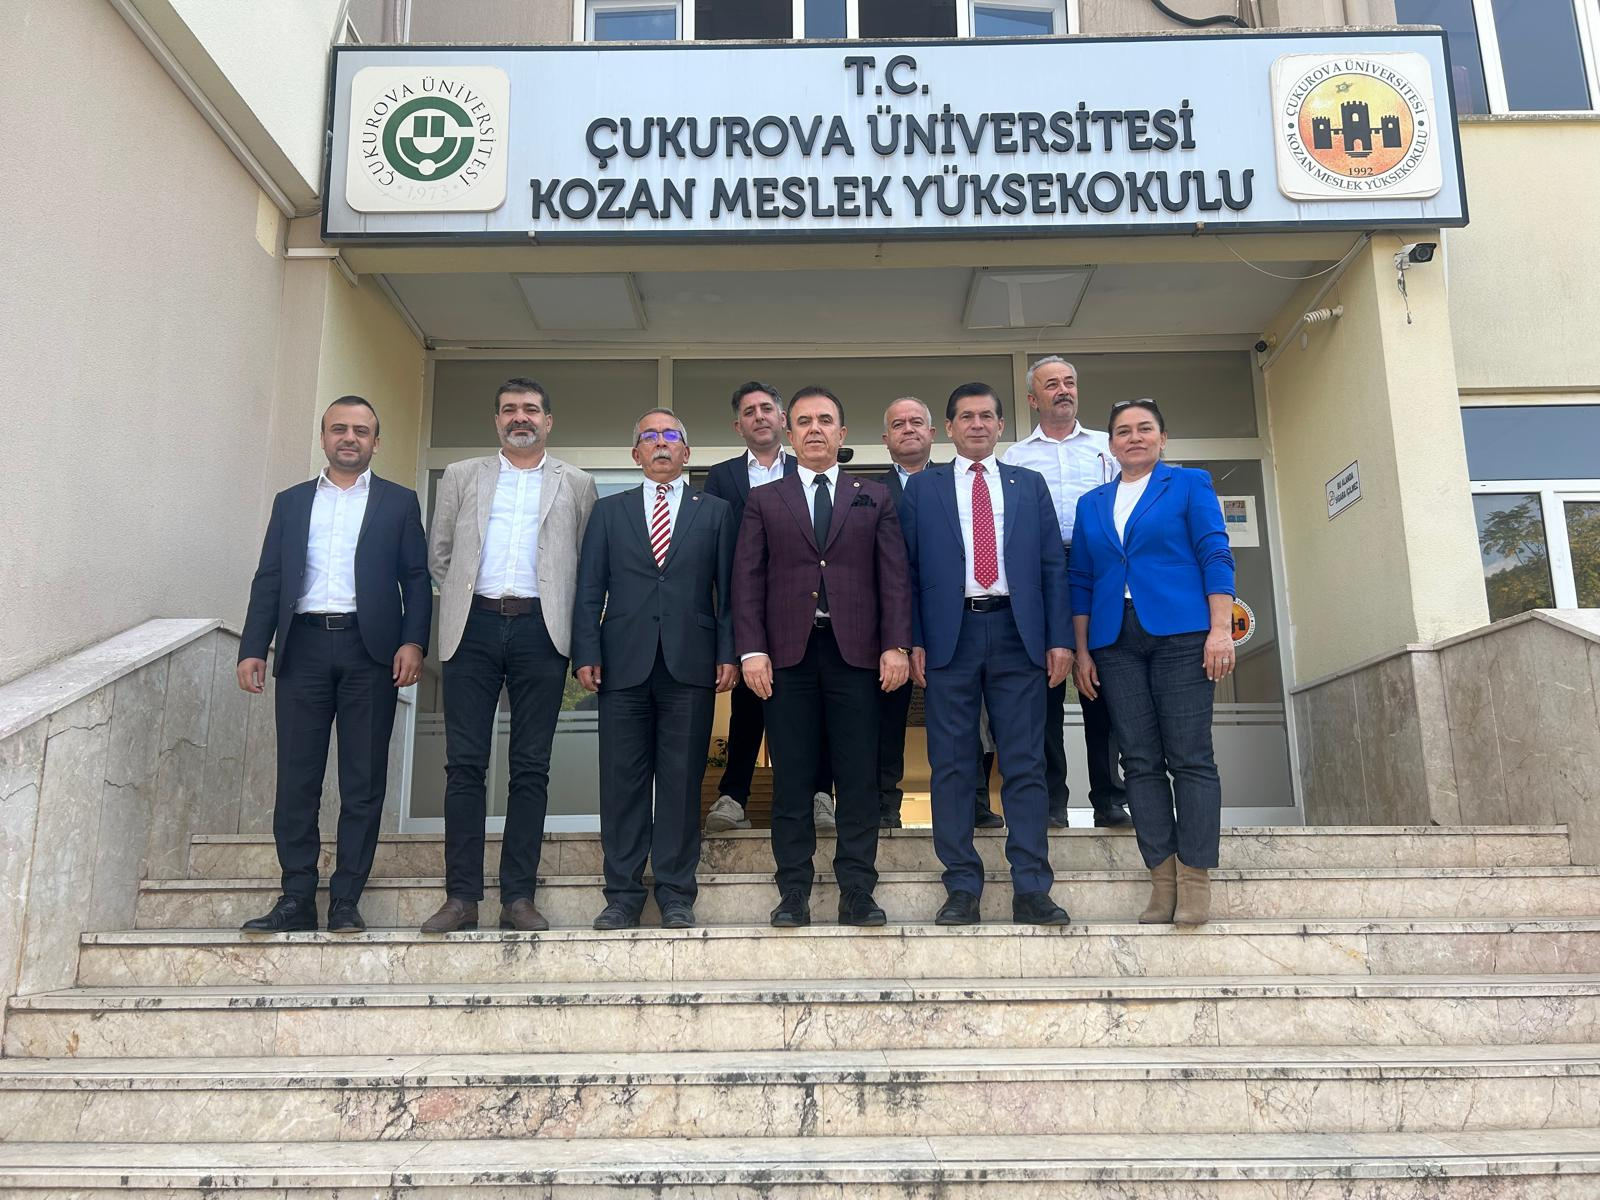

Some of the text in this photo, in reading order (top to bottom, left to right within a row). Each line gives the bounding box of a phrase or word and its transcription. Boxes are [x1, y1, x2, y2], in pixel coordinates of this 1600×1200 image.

[845, 55, 929, 96] T.C.
[1286, 59, 1428, 117] ÇUKUROVA ÜNİVERSİTESİ
[362, 76, 496, 187] ÇUKUROVA ÜNİVERSİTESİ
[586, 100, 1196, 170] ÇUKUROVA ÜNİVERSİTESİ
[1286, 130, 1428, 190] KOZAN MESLEK YÜKSEKOKULU
[408, 184, 449, 200] 1973
[530, 165, 1255, 221] KOZAN MESLEK YÜKSEKOKULU
[1348, 167, 1374, 176] 1992
